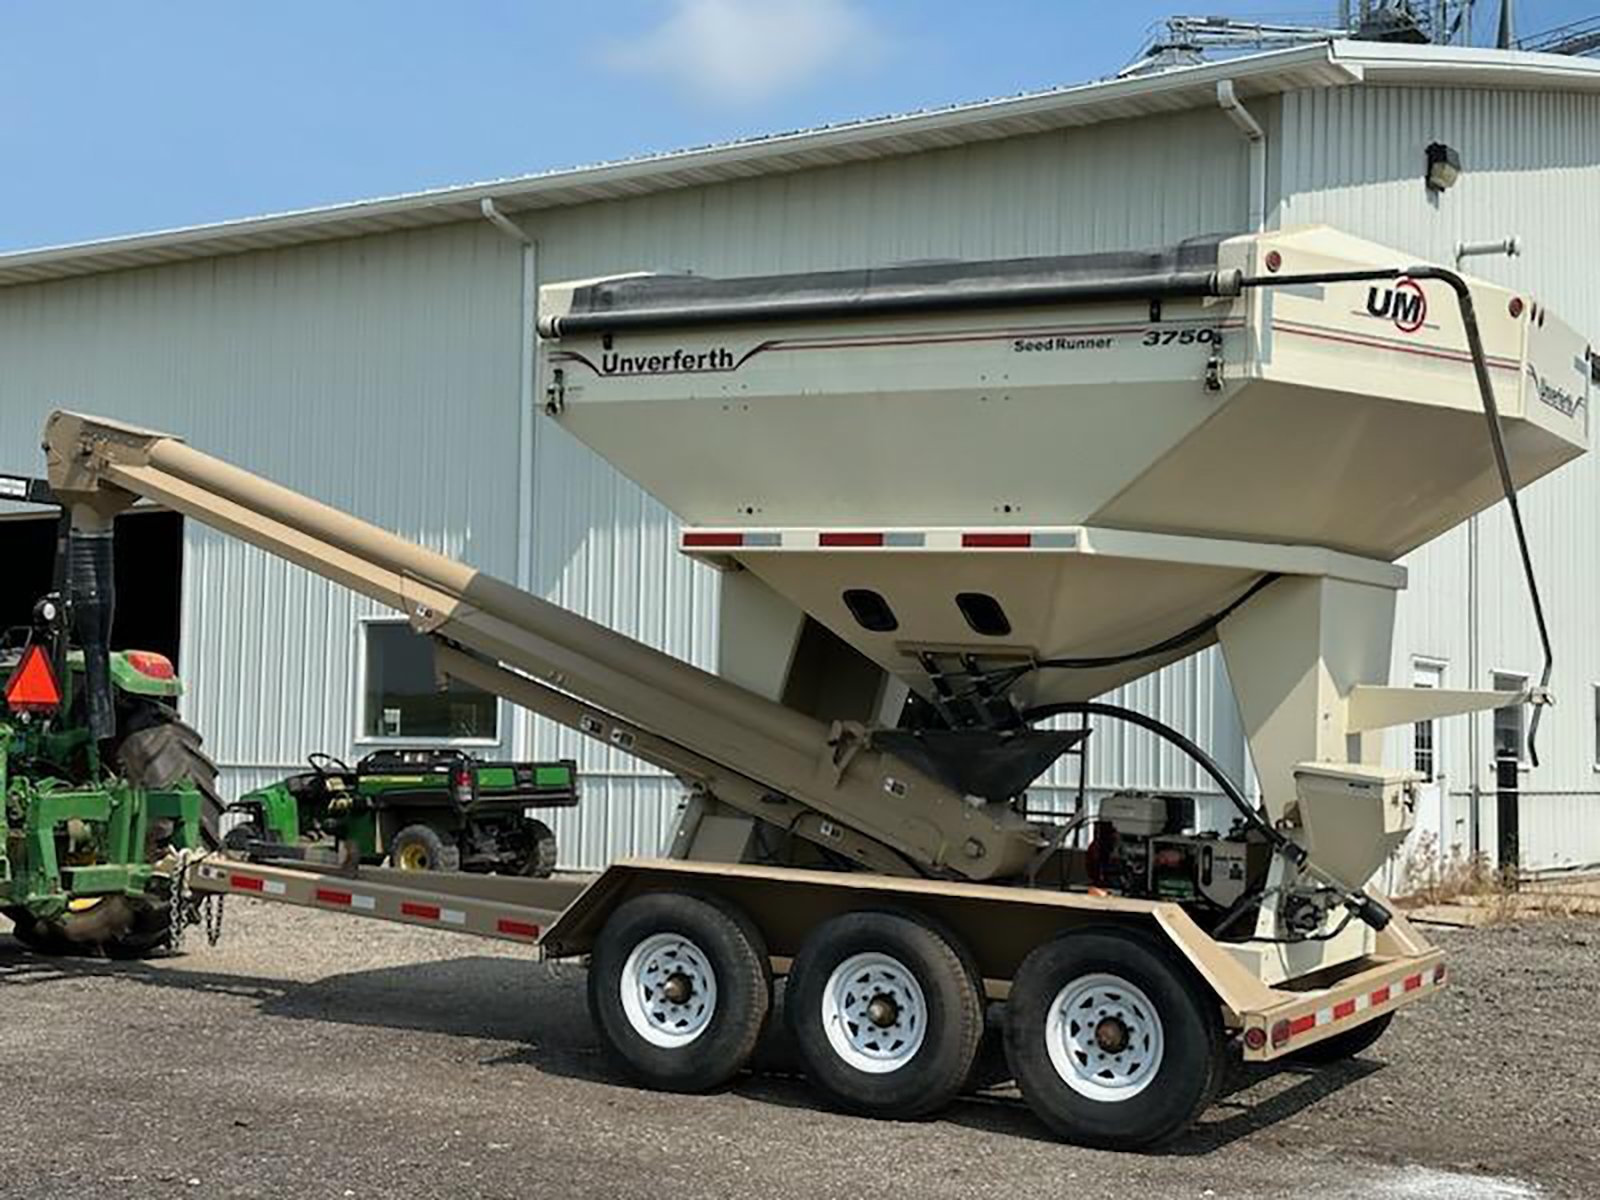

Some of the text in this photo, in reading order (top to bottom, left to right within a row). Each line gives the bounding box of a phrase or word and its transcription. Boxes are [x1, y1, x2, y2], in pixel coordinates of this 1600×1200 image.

[1367, 286, 1421, 323] UM
[1014, 338, 1112, 352] Seed Runner
[1143, 328, 1214, 346] 3750
[602, 348, 733, 373] Unverferth
